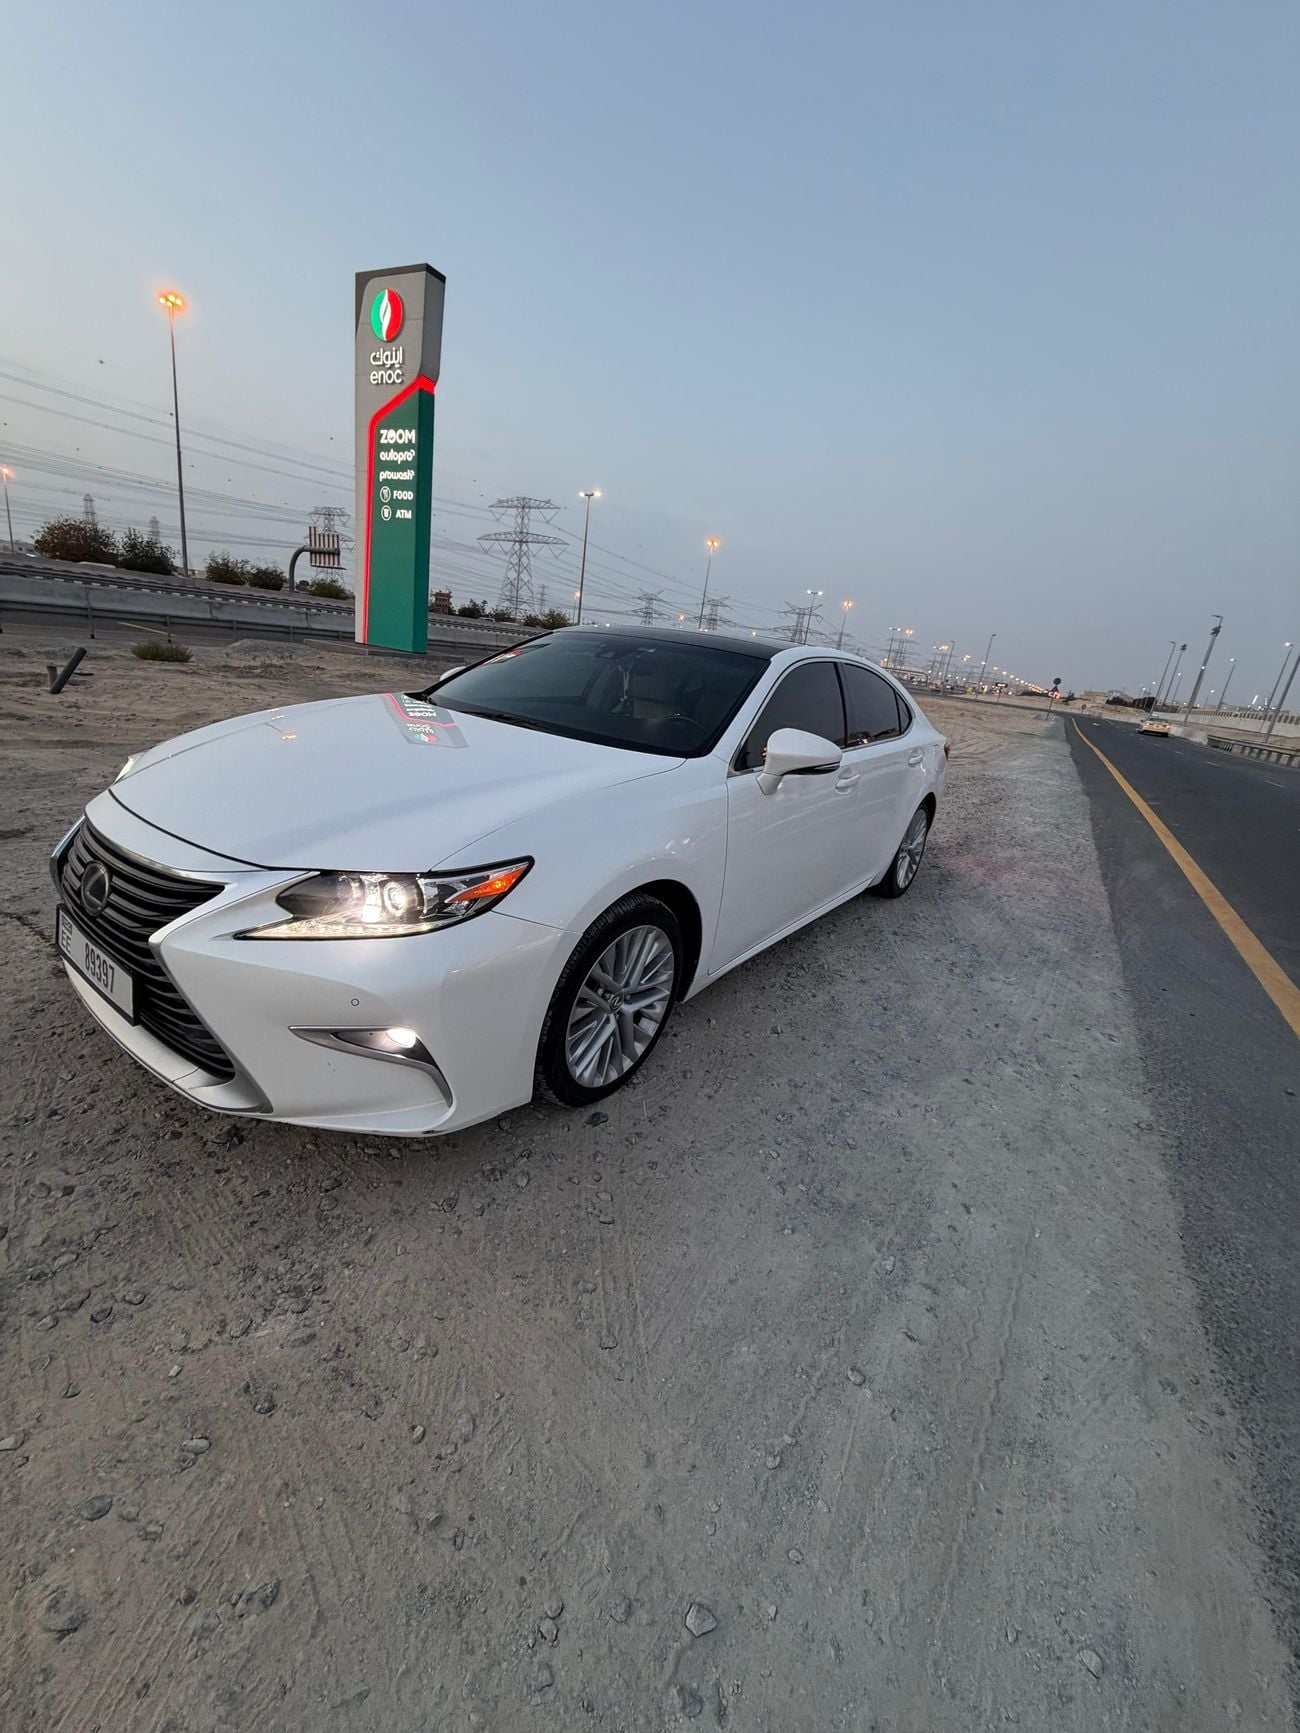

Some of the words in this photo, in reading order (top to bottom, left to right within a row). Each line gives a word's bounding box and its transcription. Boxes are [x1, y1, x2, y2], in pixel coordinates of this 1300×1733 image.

[369, 346, 403, 368] اينوك
[369, 369, 403, 385] enoc
[379, 429, 416, 444] ZOOM
[379, 448, 415, 464] autopro
[379, 469, 415, 481] prowash
[393, 490, 414, 500] FOOD
[395, 509, 412, 519] ATM
[61, 929, 71, 954] EE
[85, 942, 115, 993] 89397
